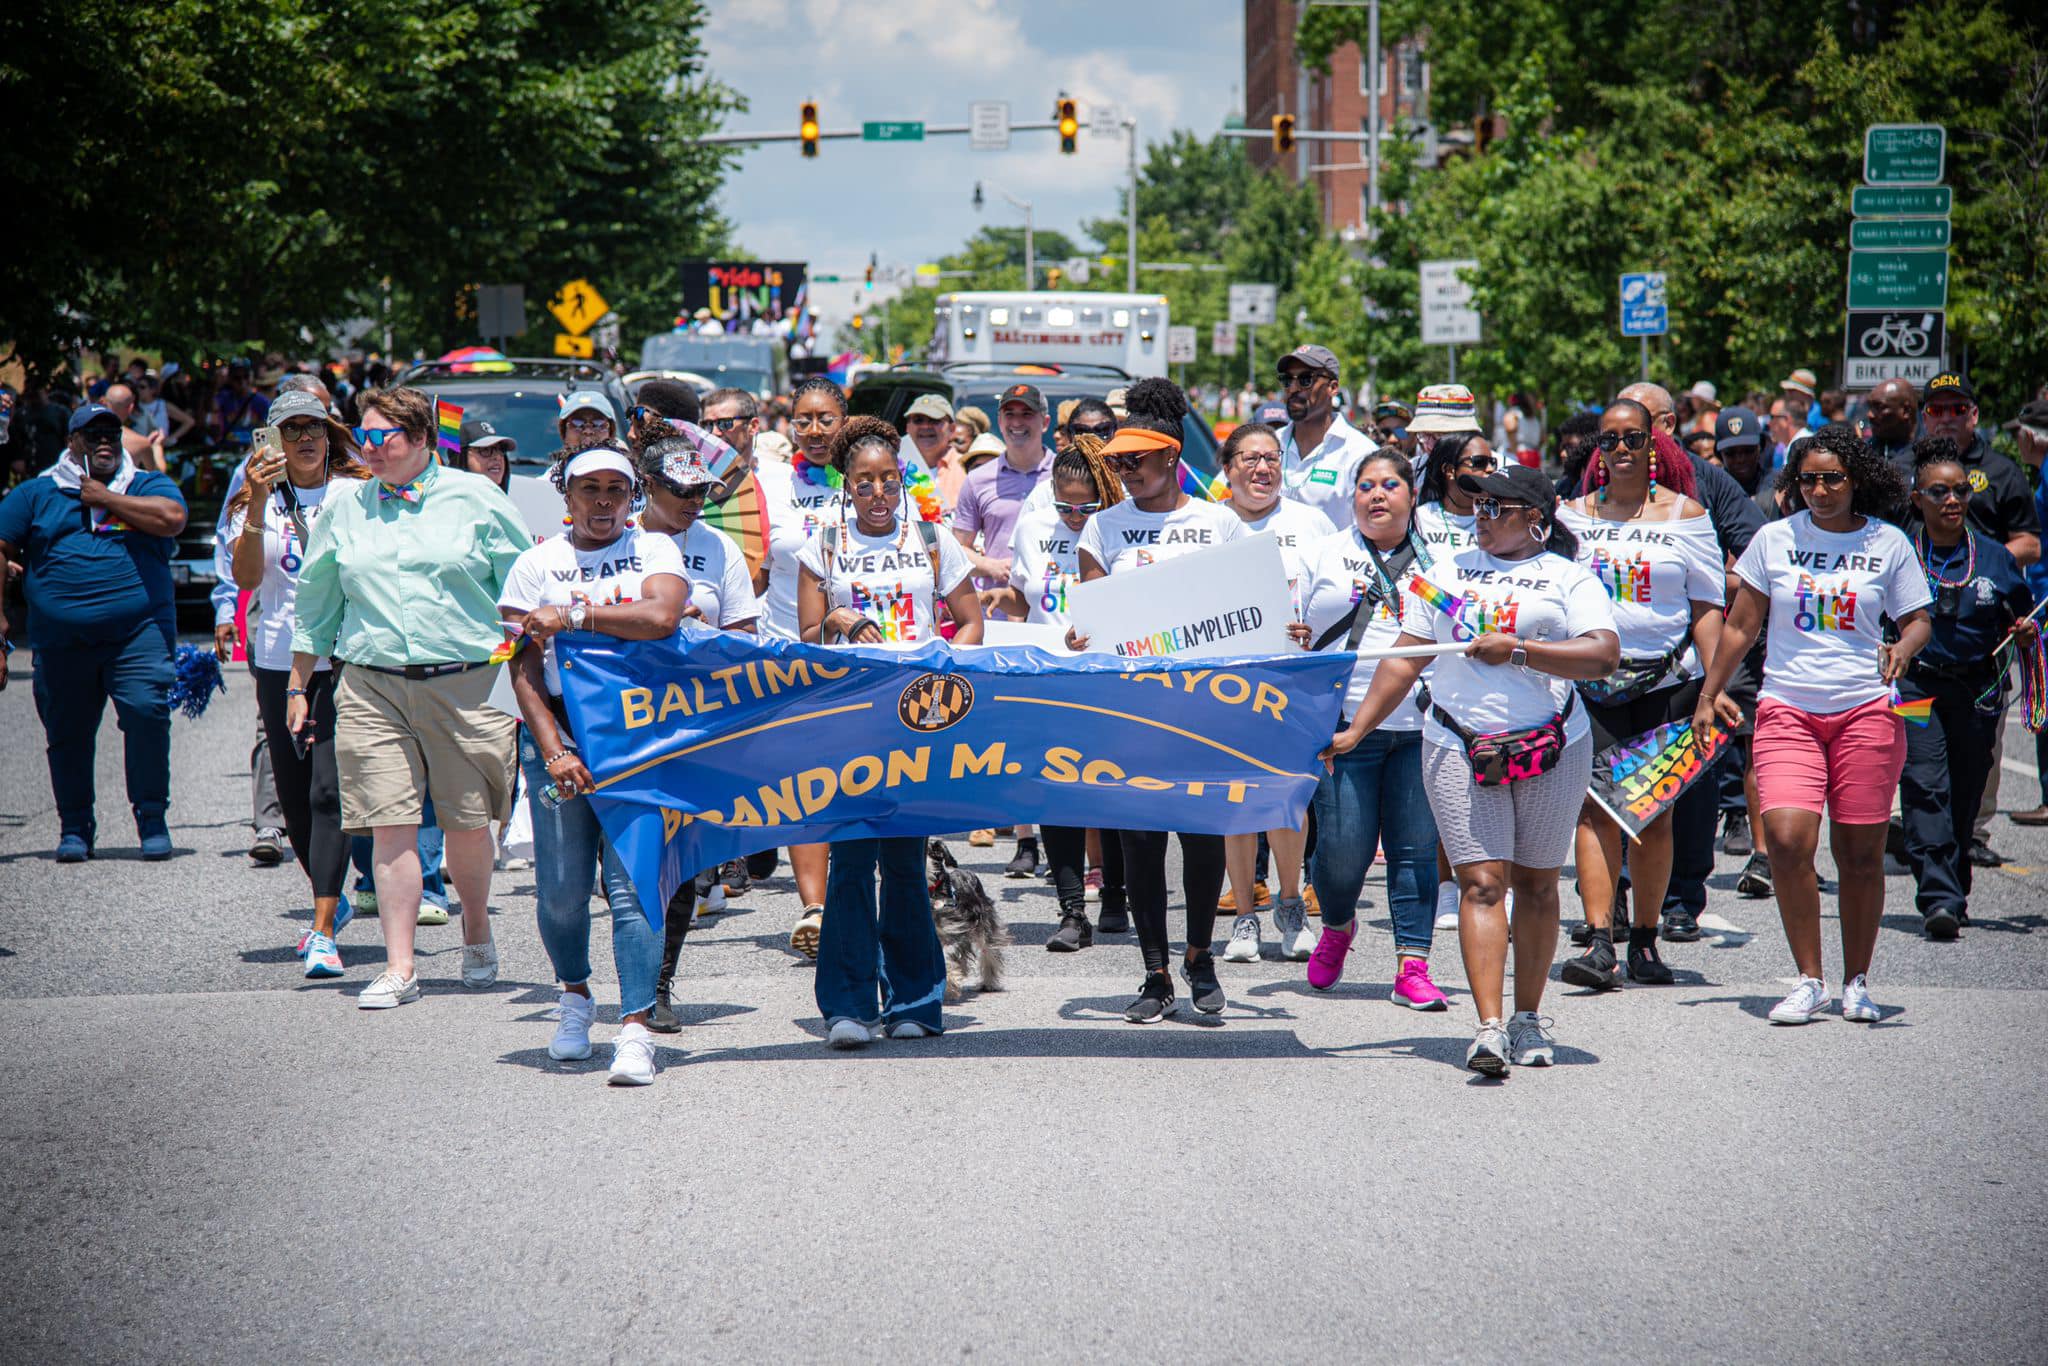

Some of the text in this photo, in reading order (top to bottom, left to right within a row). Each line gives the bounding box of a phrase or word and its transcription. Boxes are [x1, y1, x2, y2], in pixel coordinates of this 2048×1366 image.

[1855, 362, 1932, 379] BIKE LANE
[791, 494, 824, 509] WE
[1121, 528, 1213, 545] WE ARE
[1275, 534, 1297, 547] RE
[1426, 532, 1462, 546] WE
[1581, 528, 1676, 547] WE ARE
[1039, 540, 1070, 555] WE
[551, 555, 643, 583] WE ARE
[682, 554, 706, 572] RE
[837, 551, 927, 574] WE ARE
[1342, 556, 1376, 579] WE
[1786, 550, 1883, 574] WE ARE
[1456, 567, 1551, 592] WE ARE
[1603, 583, 1652, 603] RE
[1793, 611, 1857, 633] ORE
[620, 658, 1289, 730] BALTIM AYOR
[904, 685, 918, 700] CITY
[918, 676, 930, 686] OF
[949, 743, 1022, 780] M.
